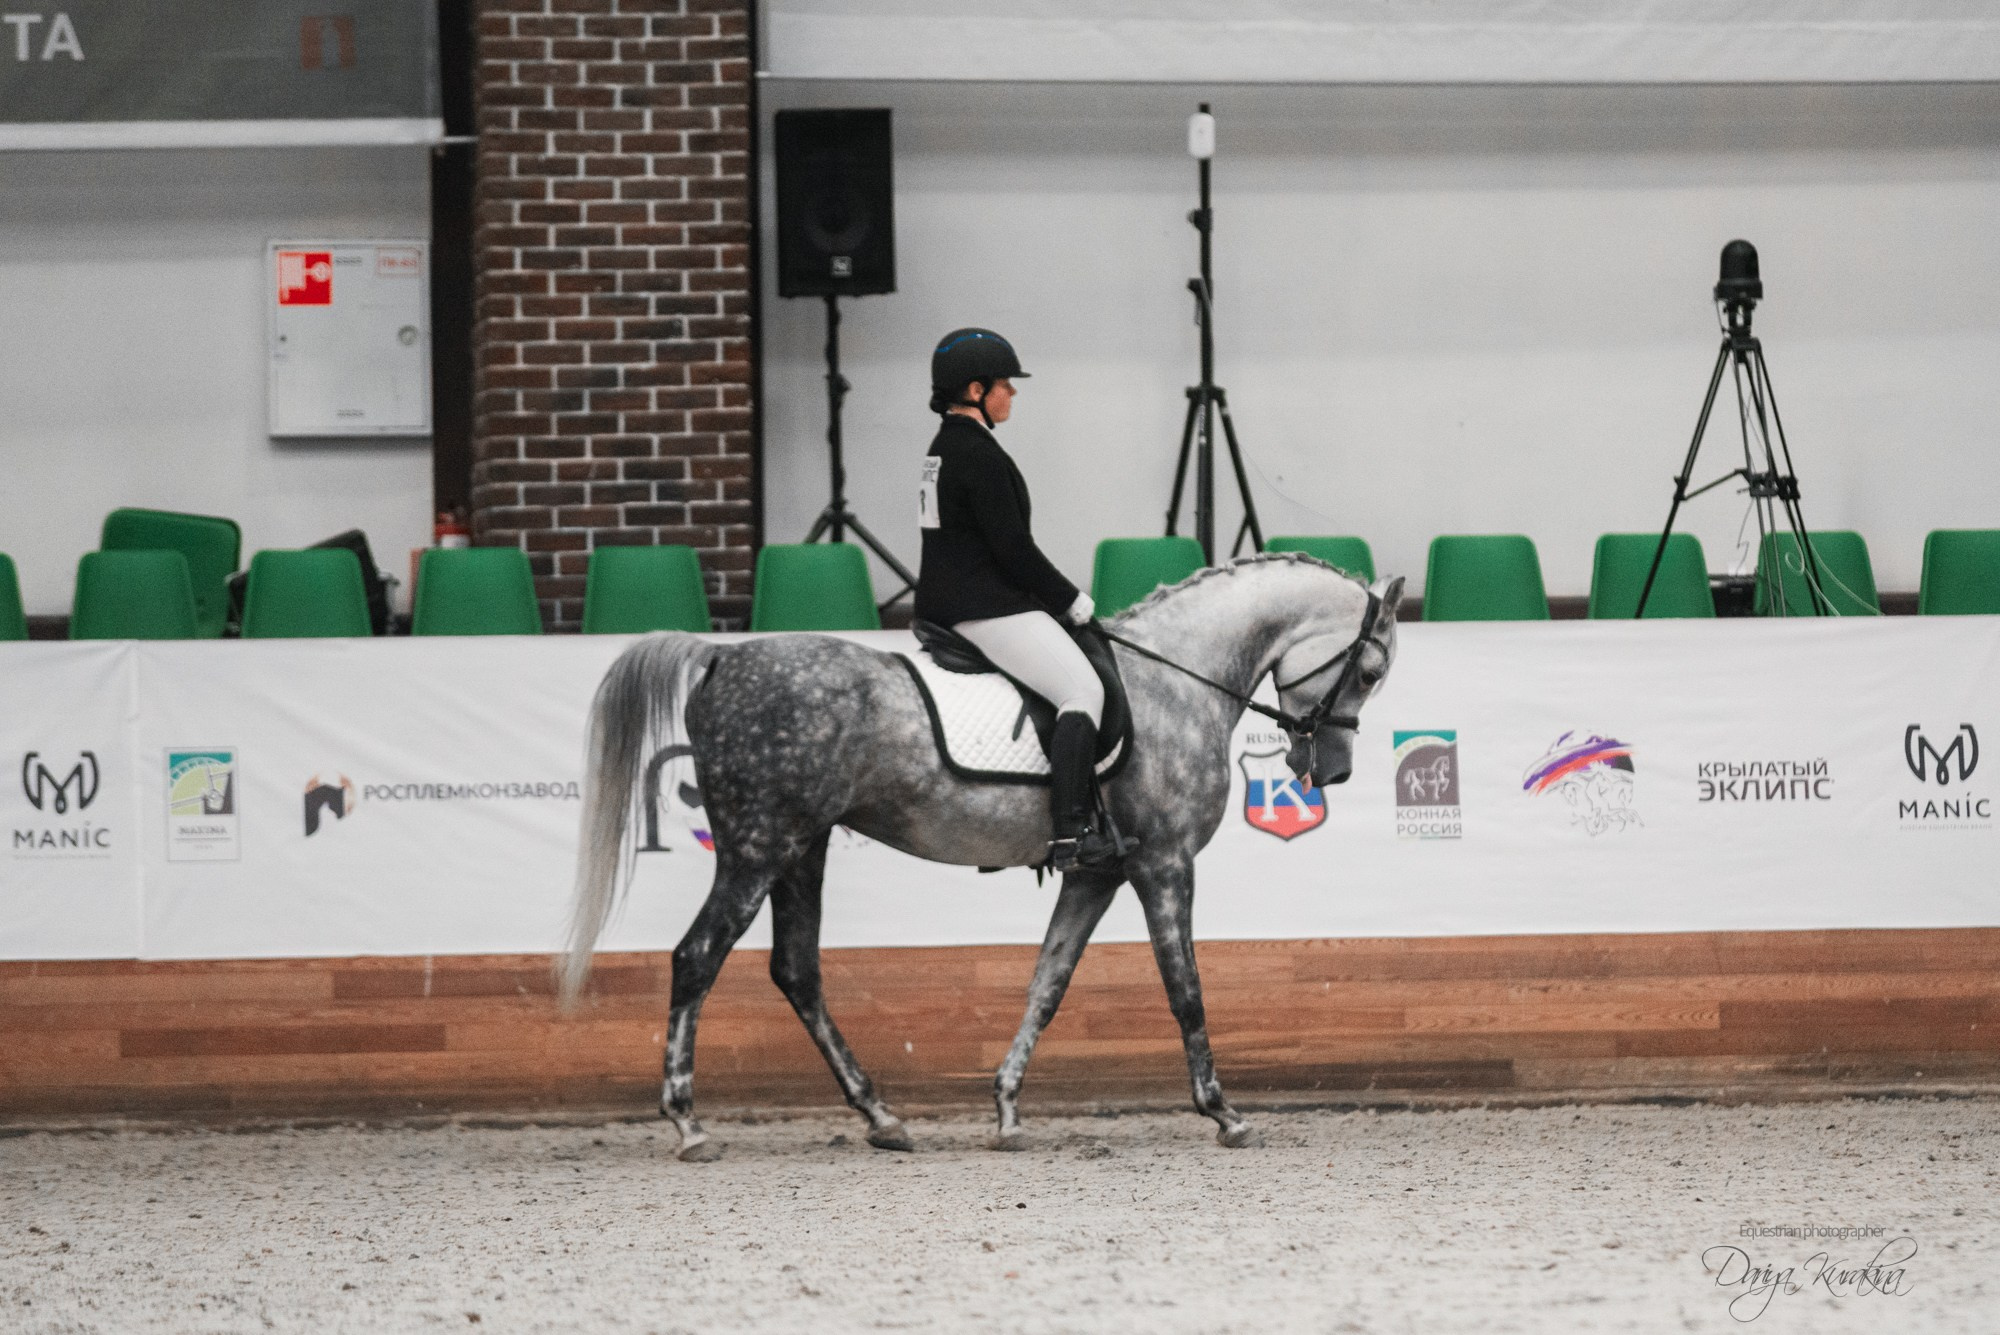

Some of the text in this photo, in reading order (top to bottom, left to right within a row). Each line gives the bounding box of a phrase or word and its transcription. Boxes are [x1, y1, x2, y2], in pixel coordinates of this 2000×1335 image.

[1698, 758, 1828, 777] КРЫЛАТЫЙ
[363, 782, 580, 801] РОСПЛЕМКОНЗАВОД
[1698, 778, 1831, 801] ЭКЛИПС
[1396, 807, 1461, 820] КОННАЯ
[1396, 822, 1462, 835] РОССИЯ
